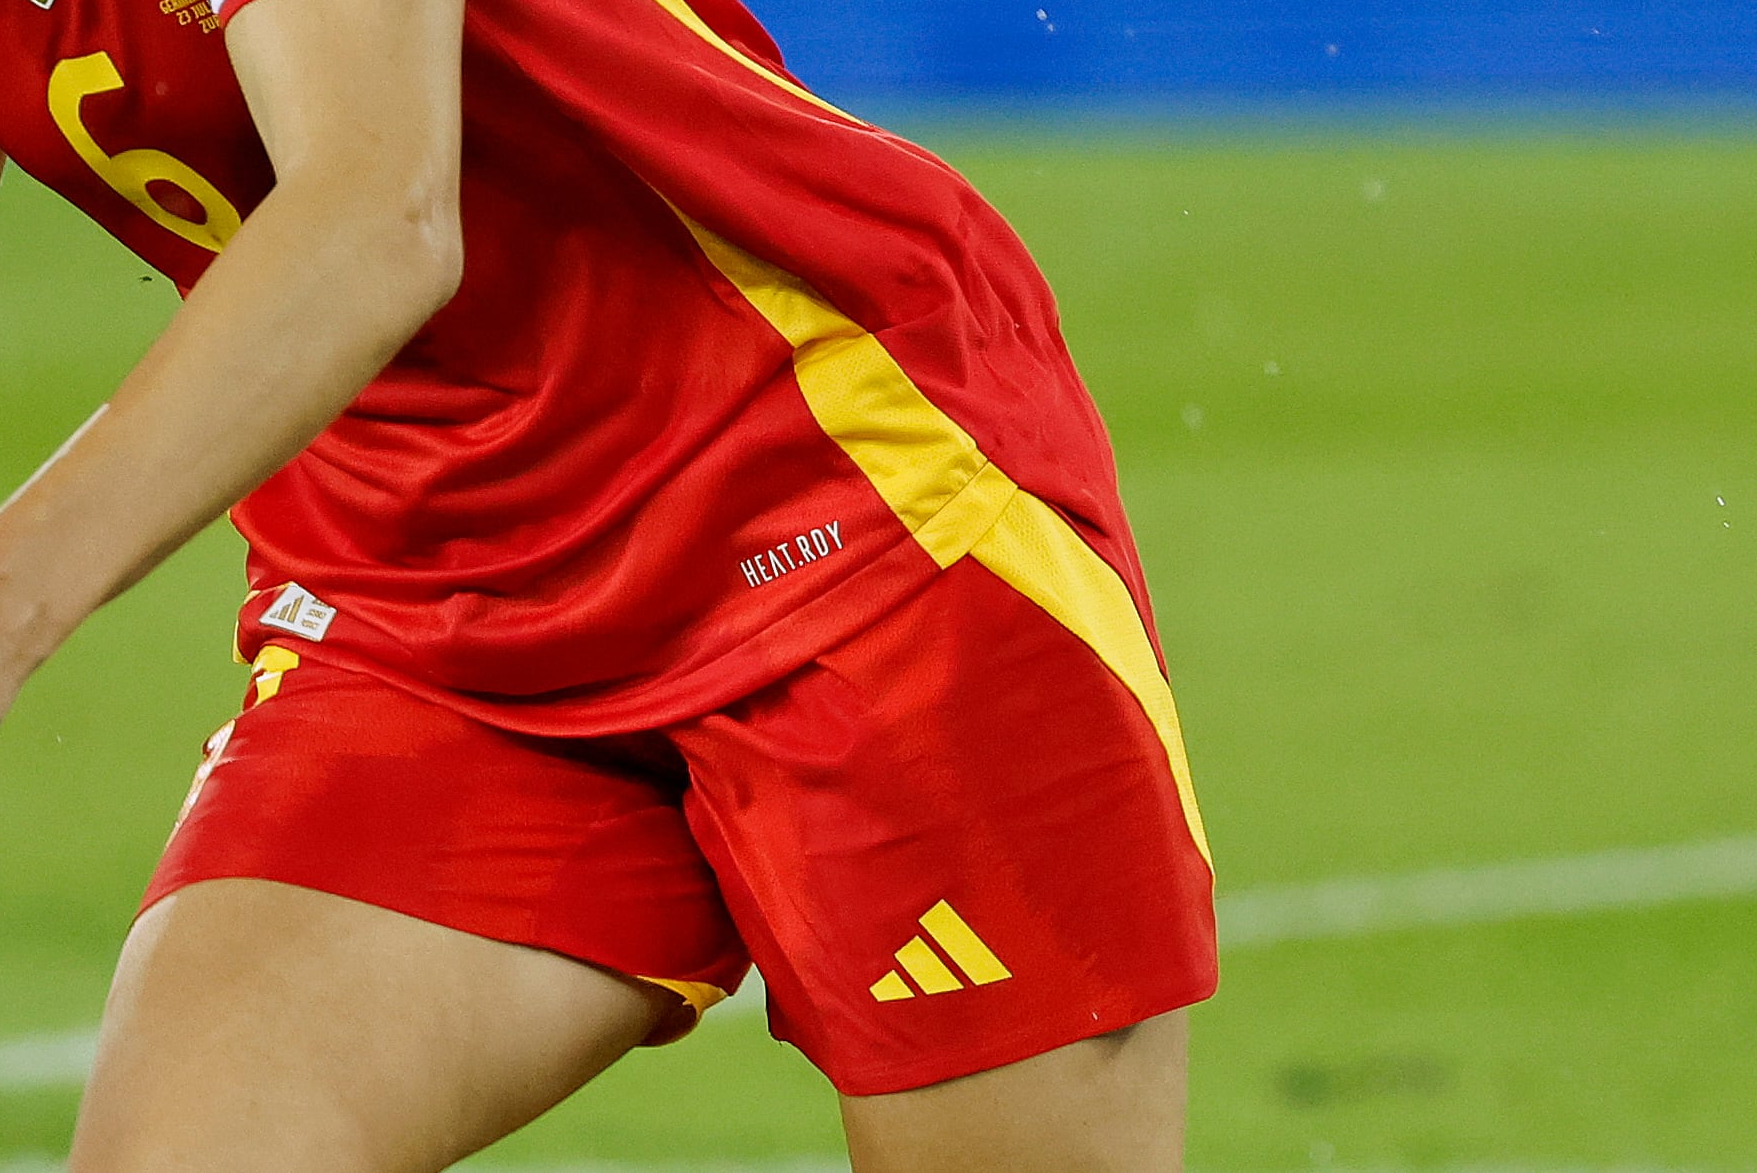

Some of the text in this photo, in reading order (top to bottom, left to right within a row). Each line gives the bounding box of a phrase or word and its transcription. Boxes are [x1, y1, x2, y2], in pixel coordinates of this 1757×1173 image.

[176, 10, 191, 25] 23
[47, 51, 242, 253] 6
[740, 520, 843, 587] HEAT.RDY
